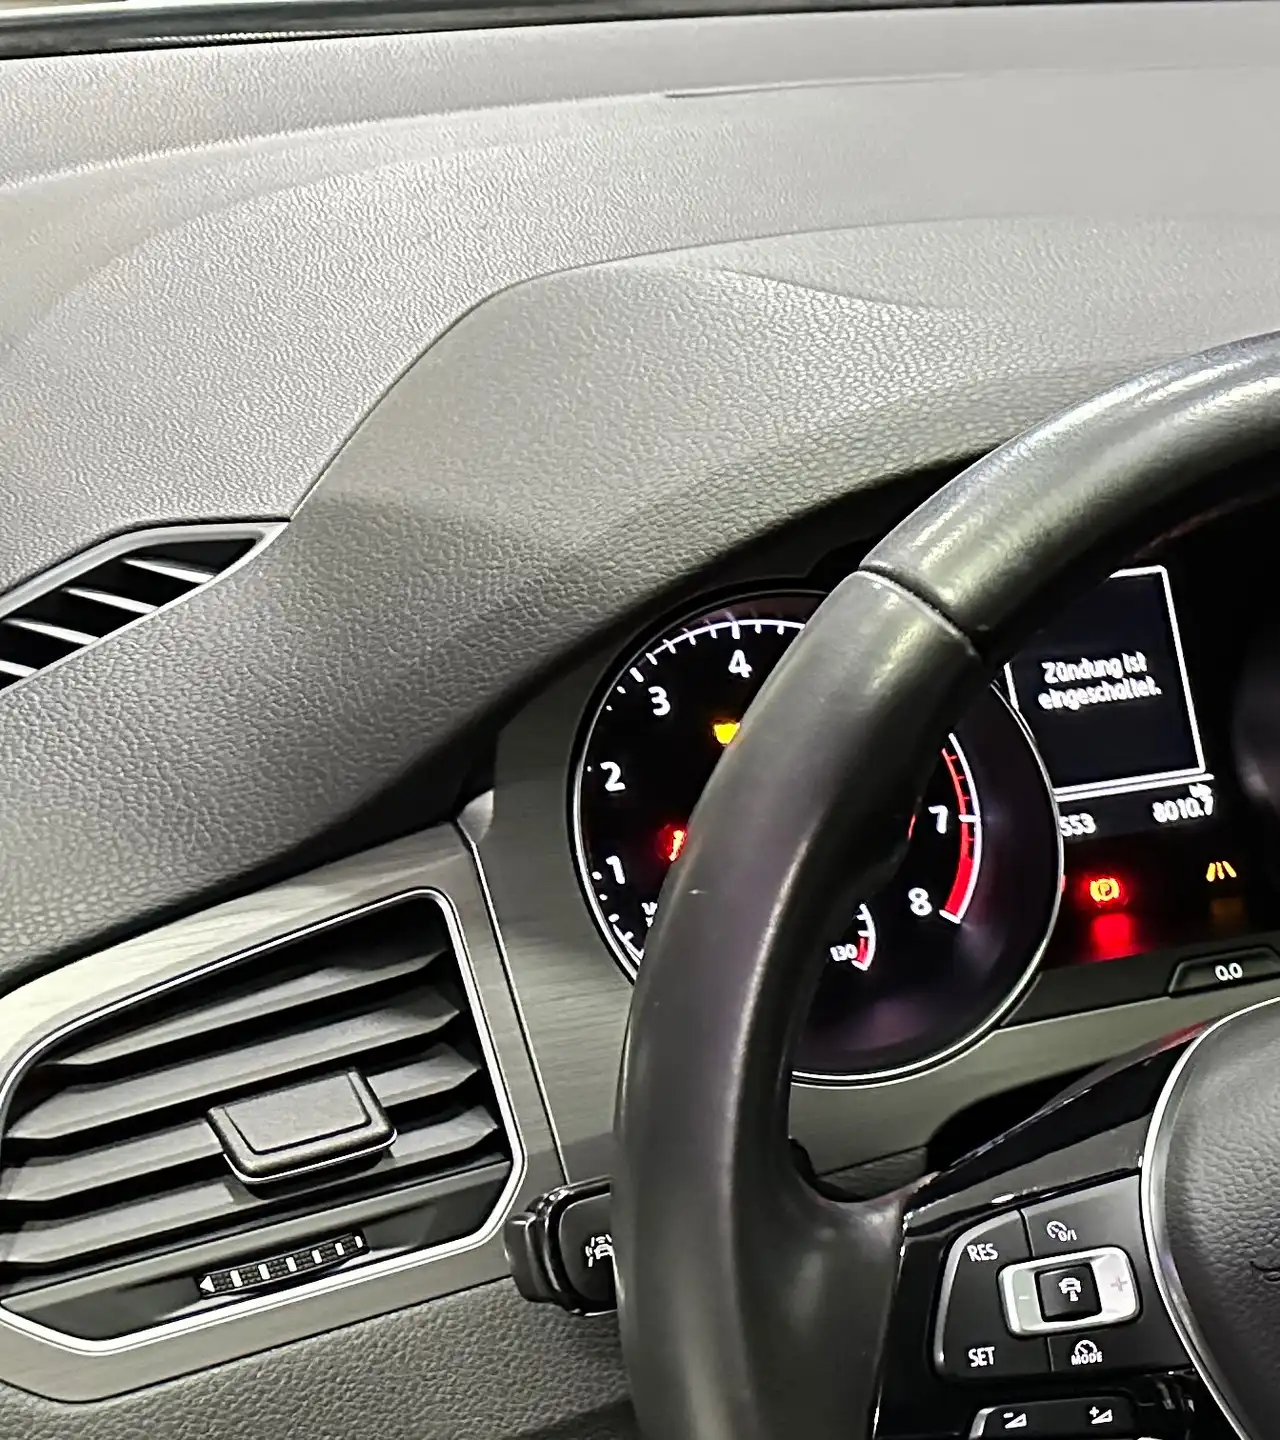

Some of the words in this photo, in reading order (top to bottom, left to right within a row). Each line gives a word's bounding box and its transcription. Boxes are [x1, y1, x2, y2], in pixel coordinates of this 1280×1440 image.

[728, 649, 753, 678] 4
[1042, 657, 1124, 684] Zündung
[648, 685, 671, 716] 3
[1038, 676, 1162, 711] eingeschaltet.
[600, 761, 626, 792] 2
[928, 806, 949, 834] 7
[606, 855, 626, 885] 1
[908, 887, 933, 917] 8
[830, 943, 858, 961] 130
[1215, 962, 1243, 981] 0.0
[967, 1244, 999, 1262] RES
[968, 1346, 996, 1367] SET
[1071, 1351, 1103, 1366] MODE
